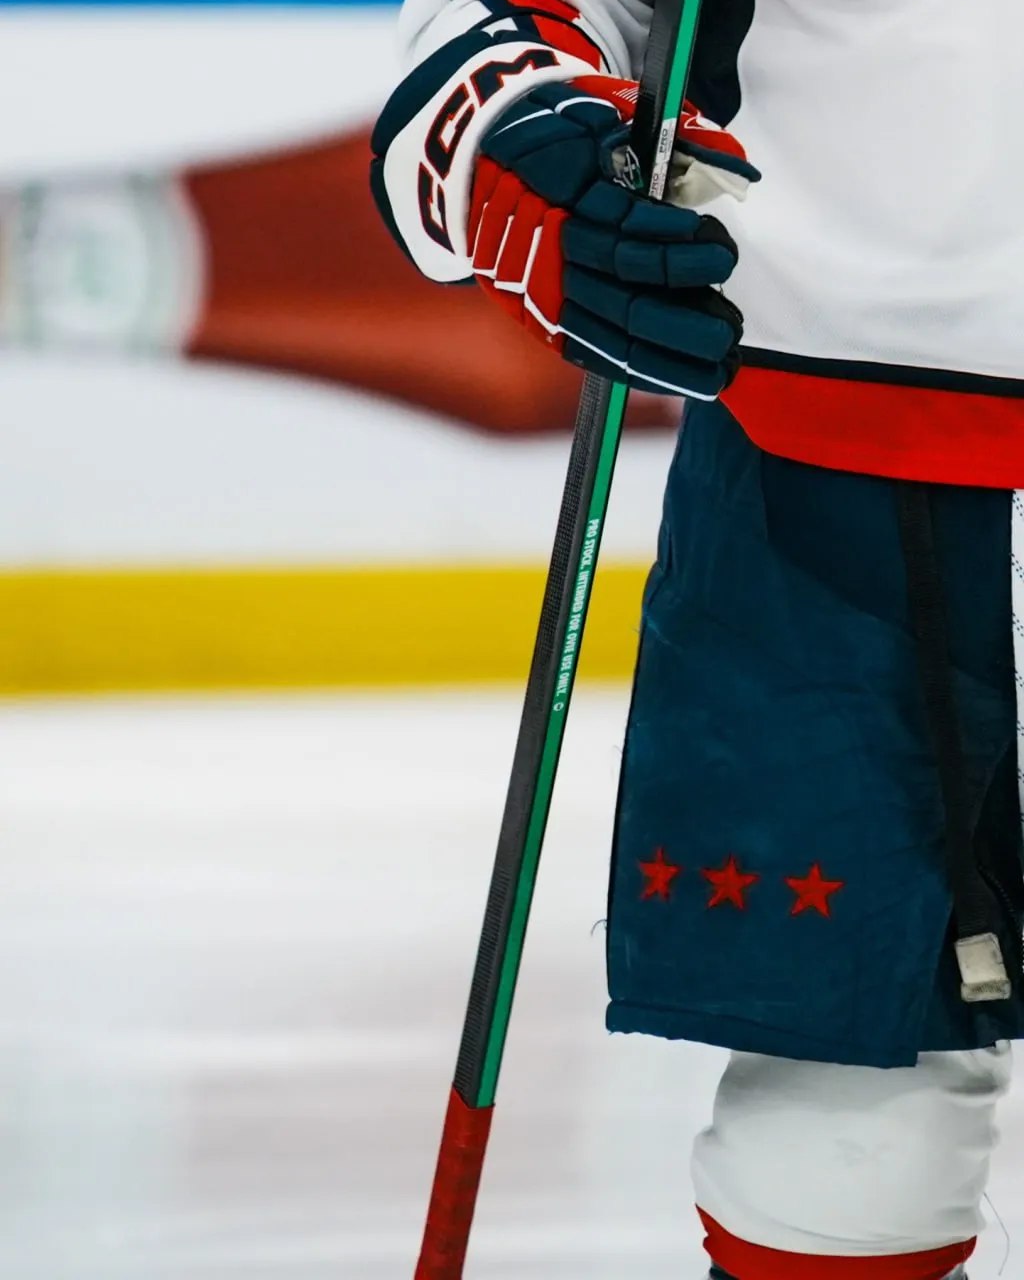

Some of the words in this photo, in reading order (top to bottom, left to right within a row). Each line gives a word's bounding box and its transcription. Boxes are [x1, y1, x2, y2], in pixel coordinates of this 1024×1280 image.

[418, 48, 561, 255] CCM
[659, 128, 669, 153] PRO
[587, 518, 600, 538] PRO
[572, 570, 590, 613] INTENDED
[568, 613, 581, 631] FOR
[560, 654, 573, 671] USE
